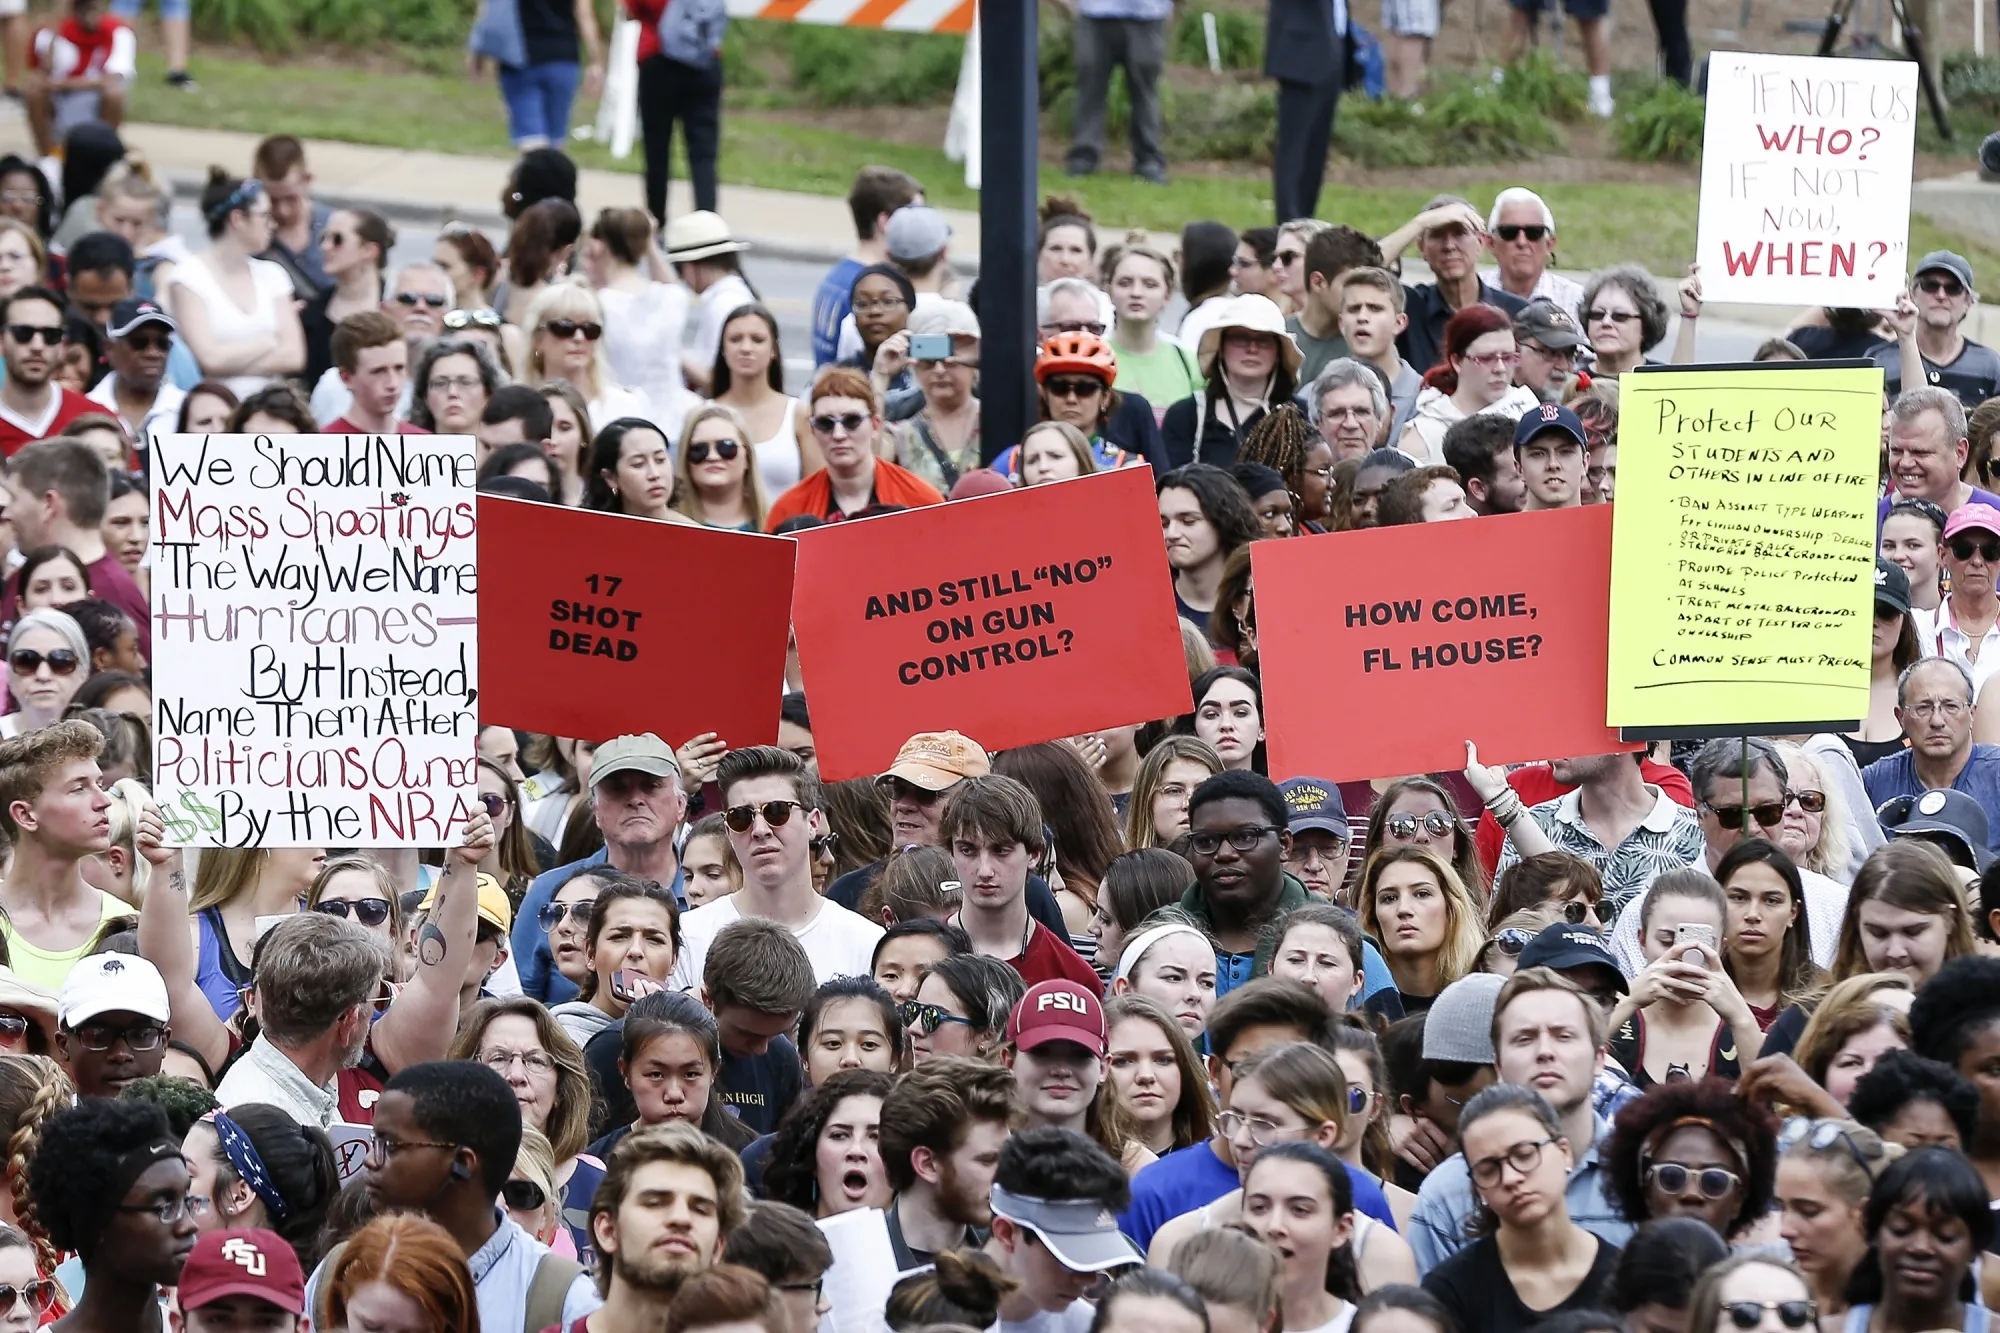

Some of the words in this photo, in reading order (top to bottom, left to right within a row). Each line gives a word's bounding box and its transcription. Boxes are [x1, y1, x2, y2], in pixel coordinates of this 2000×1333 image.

[1790, 77, 1859, 118] NOT
[1871, 84, 1913, 123] US
[1756, 124, 1881, 161] WHO?
[1730, 161, 1768, 199] IF
[1794, 166, 1879, 198] NOT
[1762, 205, 1840, 235] NOW,
[1654, 398, 1760, 434] Protect
[1774, 407, 1837, 431] OUR
[153, 434, 234, 486] We
[250, 434, 370, 488] Should
[376, 435, 477, 488] Name
[1672, 442, 1782, 463] STUDENTS
[1786, 449, 1835, 463] AND
[1669, 465, 1740, 484] OTHERS
[1747, 474, 1763, 484] IN
[1769, 473, 1809, 482] LINE
[1813, 474, 1832, 483] OF
[1834, 474, 1875, 486] FIRE
[158, 488, 269, 553] Mass
[279, 487, 477, 560] Shootings
[1677, 496, 1710, 511] BAN
[1775, 503, 1806, 518] TYPE
[153, 541, 236, 591] The
[242, 544, 319, 610] Way
[320, 544, 390, 593] We
[393, 545, 478, 595] Name
[585, 573, 622, 597] 17
[1678, 559, 1734, 576] PROVIDE
[1678, 578, 1692, 588] AT
[865, 587, 933, 620] AND
[937, 569, 1032, 607] STILL
[1345, 599, 1422, 628] HOW
[1432, 593, 1537, 623] COME,
[1676, 595, 1721, 609] TREAT
[549, 599, 642, 632] SHOT
[926, 615, 974, 644] ON
[982, 601, 1055, 635] GUN
[1736, 618, 1752, 627] OF
[1757, 618, 1788, 628] TEST
[549, 628, 638, 662] DEAD
[898, 629, 1074, 685] CONTROL?
[1363, 648, 1401, 673] FL
[1411, 634, 1543, 670] HOUSE?
[1653, 649, 1724, 667] COMMON
[1731, 654, 1773, 666] SENSE
[1777, 655, 1814, 665] MUST
[240, 644, 336, 702] But
[339, 642, 478, 709] Instead,
[158, 697, 256, 737] Name
[256, 701, 368, 738] Them
[373, 698, 475, 737] After
[156, 737, 369, 790] Politicians
[372, 735, 479, 790] Owned
[1283, 789, 1296, 802] USS
[1297, 785, 1328, 799] FLASHER
[210, 789, 271, 848] By
[277, 790, 361, 842] the
[369, 791, 471, 841] NRA
[1038, 991, 1087, 1014] FSU
[222, 1238, 266, 1276] FSU
